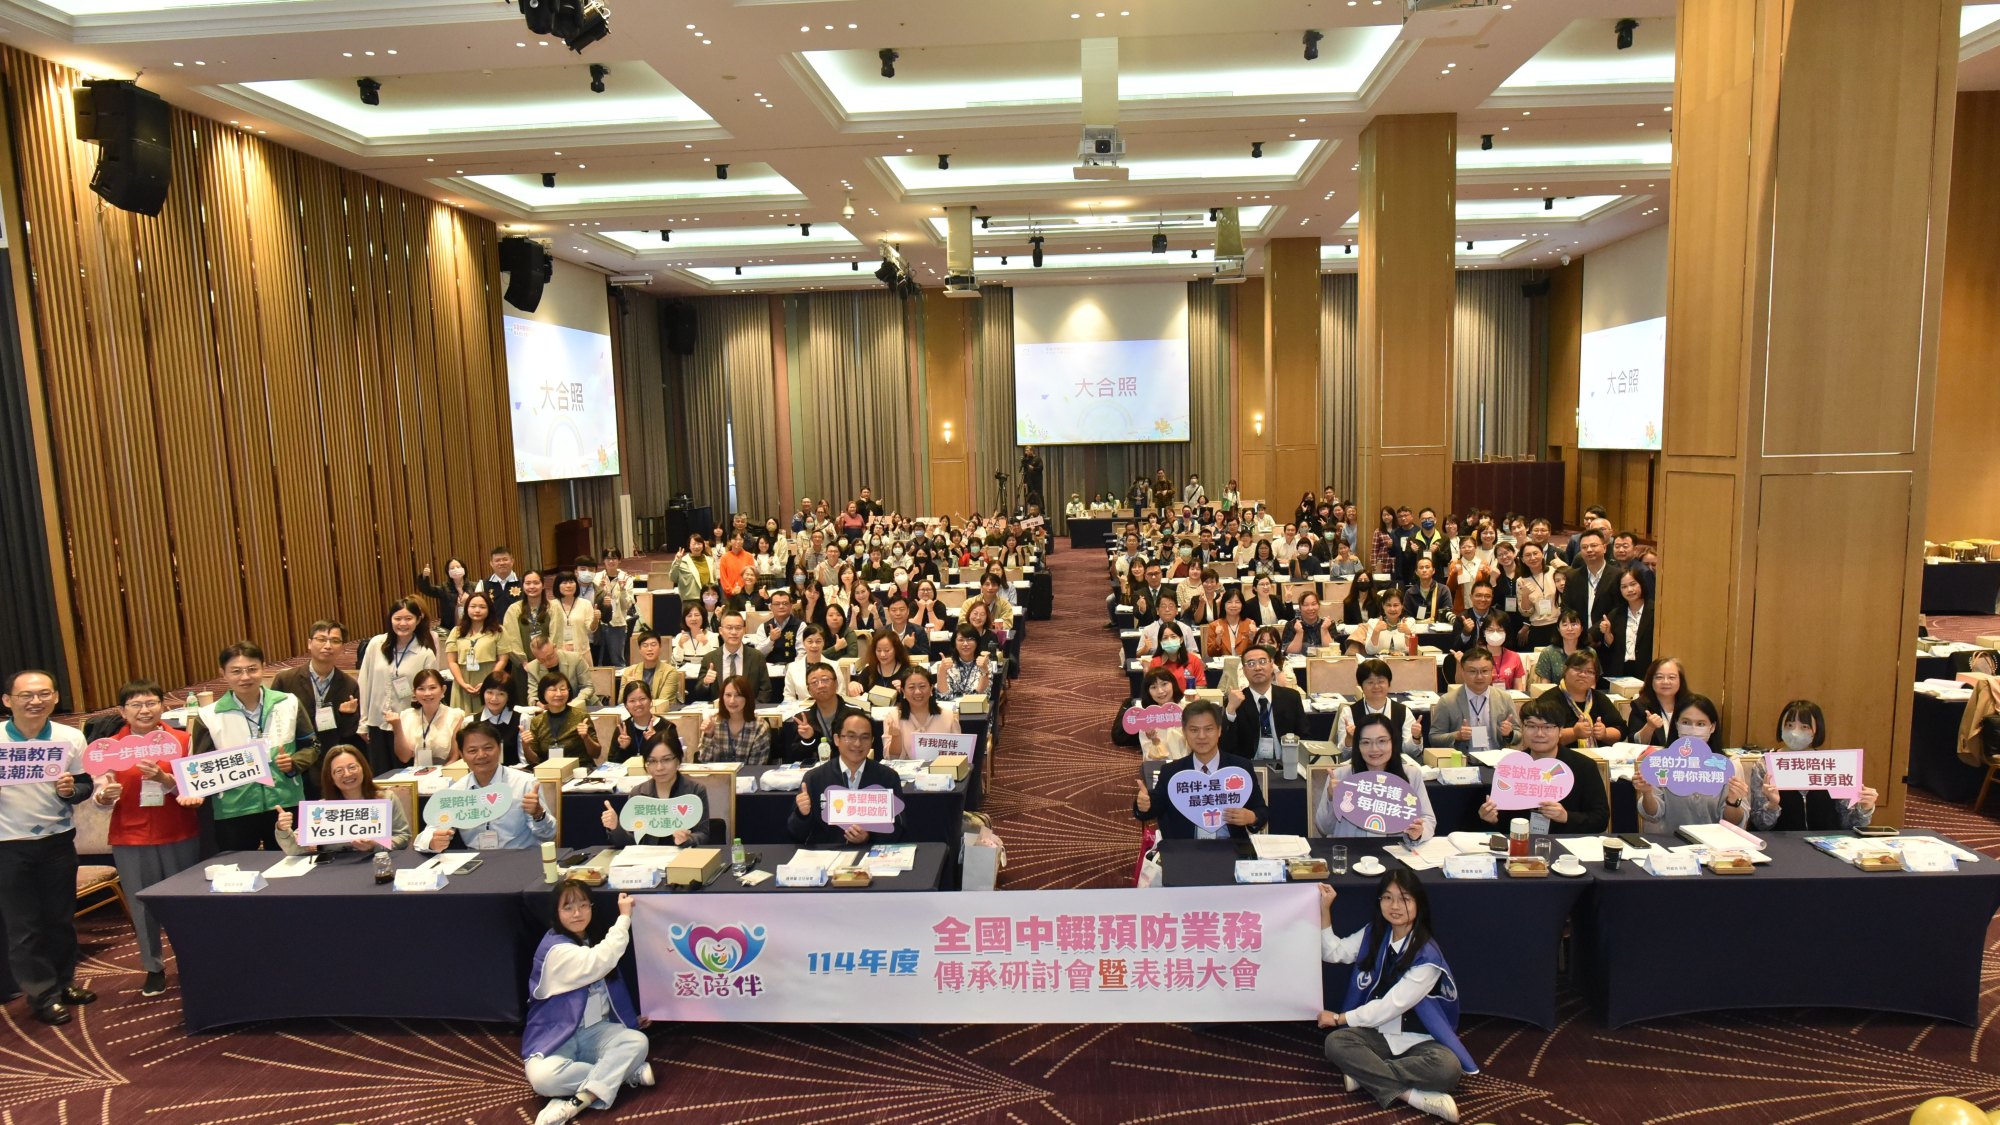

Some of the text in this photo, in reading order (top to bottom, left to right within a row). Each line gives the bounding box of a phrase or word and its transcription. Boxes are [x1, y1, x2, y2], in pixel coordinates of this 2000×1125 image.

[1075, 377, 1138, 398] 大合照
[1607, 369, 1639, 394] 大合照
[540, 380, 584, 412] 大合照
[918, 737, 958, 749] 有我陪伴
[89, 742, 177, 763] 每一步都算數
[200, 753, 245, 774] 零拒絕
[1649, 755, 1700, 768] 愛的力量
[1776, 758, 1836, 771] 有我陪伴
[190, 765, 261, 792] Yes I Can!
[1498, 765, 1542, 779] 零缺席
[1672, 770, 1725, 783] 帶你飛翔
[1808, 774, 1853, 787] 更勇敢
[1343, 779, 1403, 801] 一起守護
[1513, 782, 1563, 799] 愛到齊!
[439, 795, 477, 809] 愛陪伴
[847, 793, 888, 804] 希望無限
[1188, 793, 1241, 807] 最美禮物
[325, 808, 369, 822] 零拒絕
[455, 807, 492, 821] 心連心
[634, 804, 668, 816] 愛陪伴
[1357, 796, 1417, 820] 每個孩子
[311, 823, 382, 837] Yes I Can!
[649, 818, 683, 829] 心連心
[932, 911, 1263, 953] 全國中輟預防業務
[807, 948, 920, 976] 114年度
[934, 957, 1261, 992] 傳承研討會暨表揚大會
[674, 973, 764, 997] 愛陪伴
